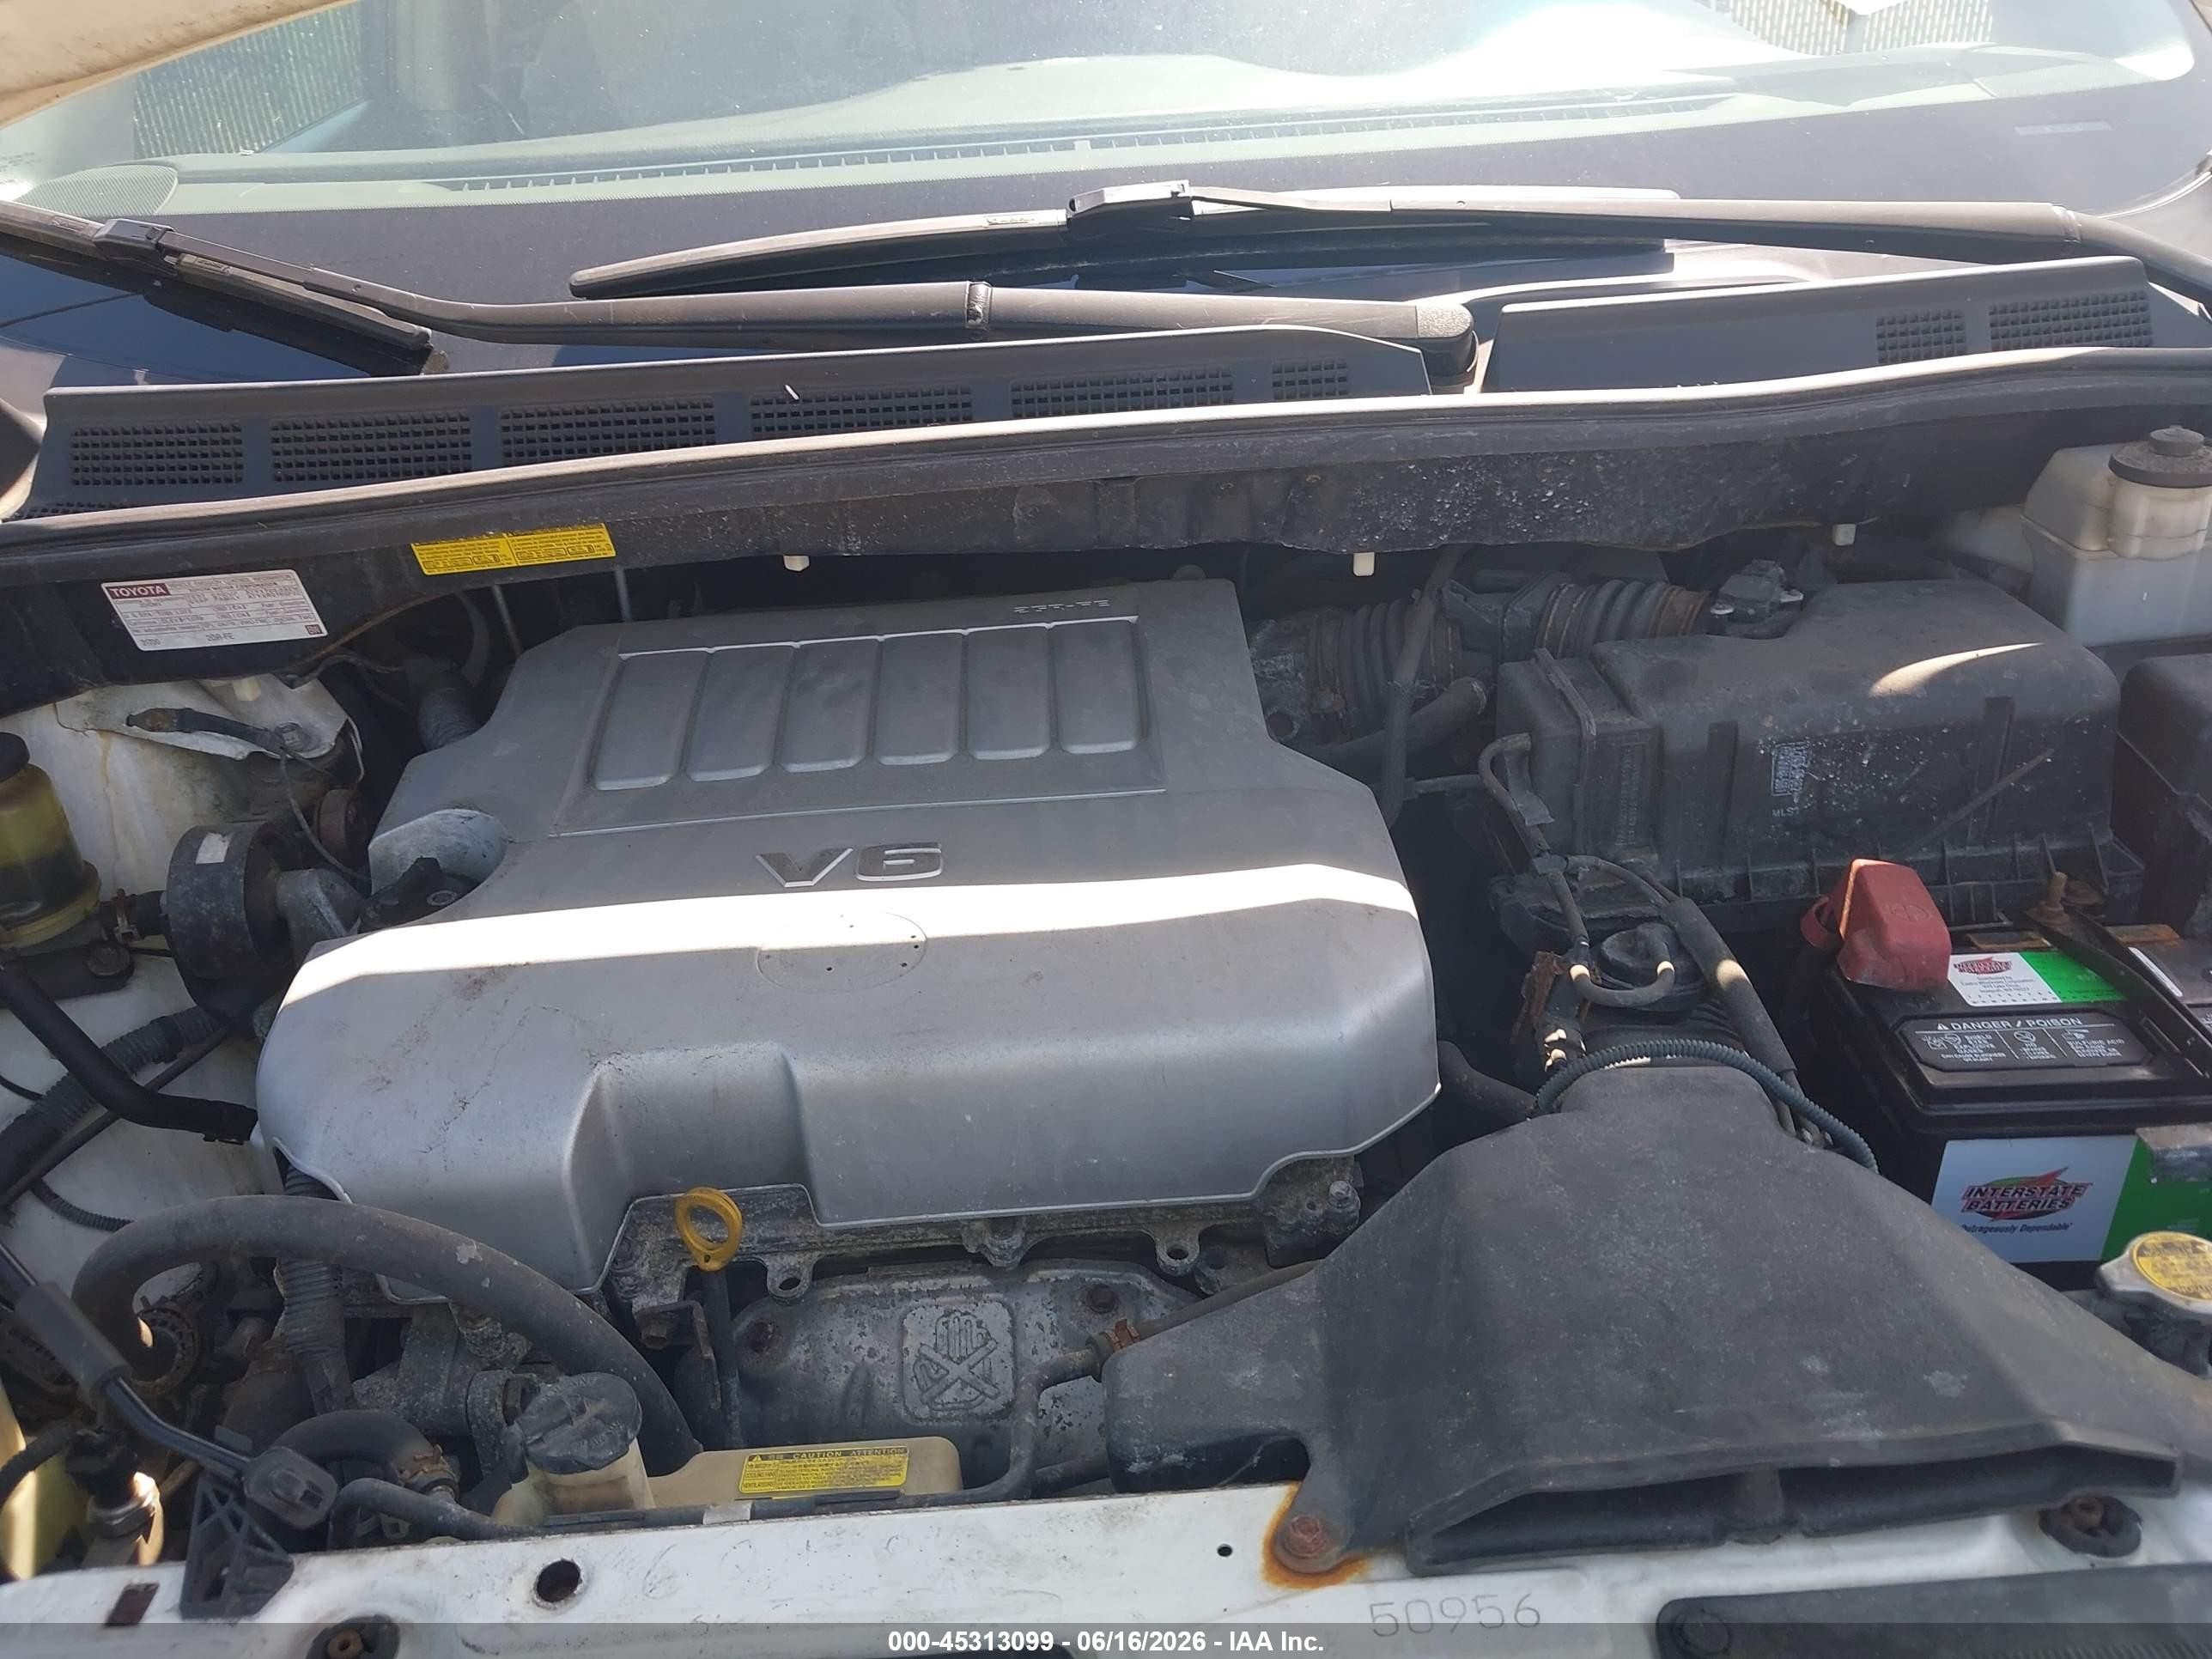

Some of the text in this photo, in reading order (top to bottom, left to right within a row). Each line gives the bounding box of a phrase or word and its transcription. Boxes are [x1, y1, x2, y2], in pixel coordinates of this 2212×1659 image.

[109, 585, 167, 598] TOYOTA
[755, 842, 941, 888] V6
[1950, 1020, 2012, 1030] DANGER
[2026, 1018, 2082, 1028] POISON
[1964, 1184, 2087, 1199] INTERSTATE
[1965, 1197, 2072, 1212] BATTERIES
[793, 1450, 842, 1460] CAUTION
[851, 1447, 904, 1458] ATTENTION
[1369, 1593, 1540, 1638] 50956
